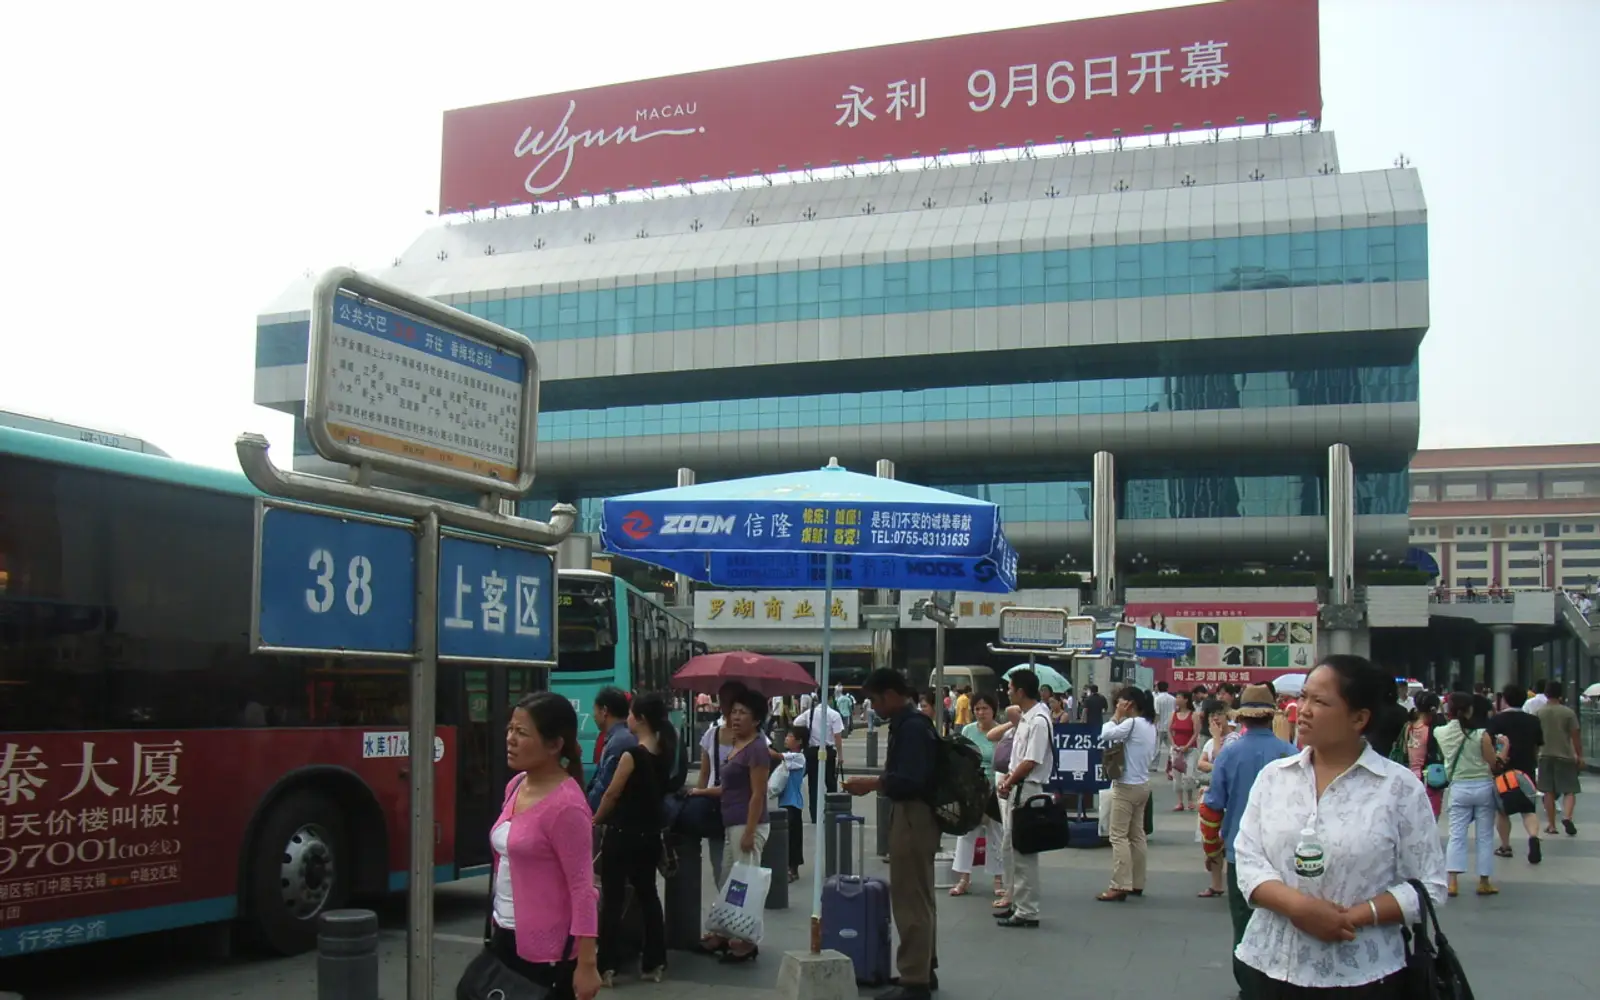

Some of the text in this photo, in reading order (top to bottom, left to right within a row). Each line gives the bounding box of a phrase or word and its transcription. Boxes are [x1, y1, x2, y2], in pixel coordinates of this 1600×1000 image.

[835, 39, 1230, 127] 永利 9月6日开幕
[635, 102, 697, 122] MACAU
[340, 303, 387, 333] 公共大巴
[424, 332, 444, 353] 开往
[659, 514, 737, 536] ZOOM
[743, 512, 794, 538] 信隆
[871, 510, 972, 531] 是我们不变的诚挚奉献
[305, 548, 373, 616] 38
[444, 564, 541, 636] 上客区
[708, 596, 848, 622] 罗湖商业城
[1173, 671, 1251, 683] 网上罗湖商业城
[0, 739, 183, 806] 泰大厦
